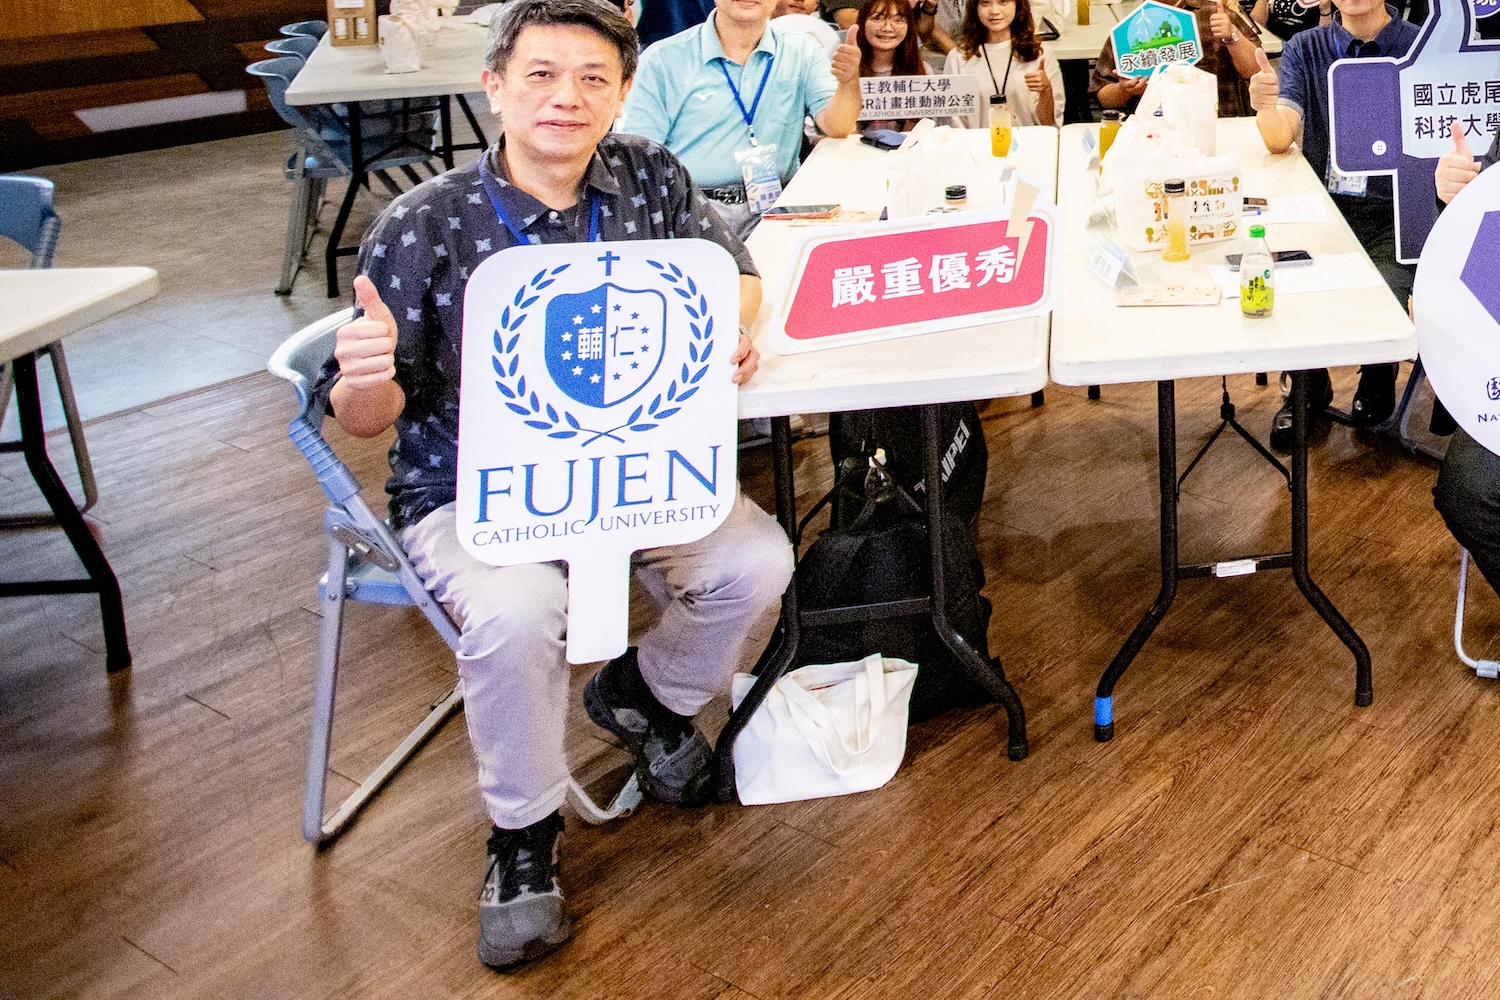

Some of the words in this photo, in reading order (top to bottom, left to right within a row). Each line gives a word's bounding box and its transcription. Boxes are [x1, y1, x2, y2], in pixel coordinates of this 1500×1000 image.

[1121, 41, 1196, 72] 永續發展
[869, 110, 904, 118] CATHOLIC
[904, 109, 944, 117] UNIVERSITY
[831, 244, 1016, 308] 嚴重優秀
[577, 326, 635, 360] 輔仁
[474, 444, 722, 526] FUJEN
[472, 519, 586, 547] CATHOLIC
[599, 503, 721, 532] UNIVERSITY
